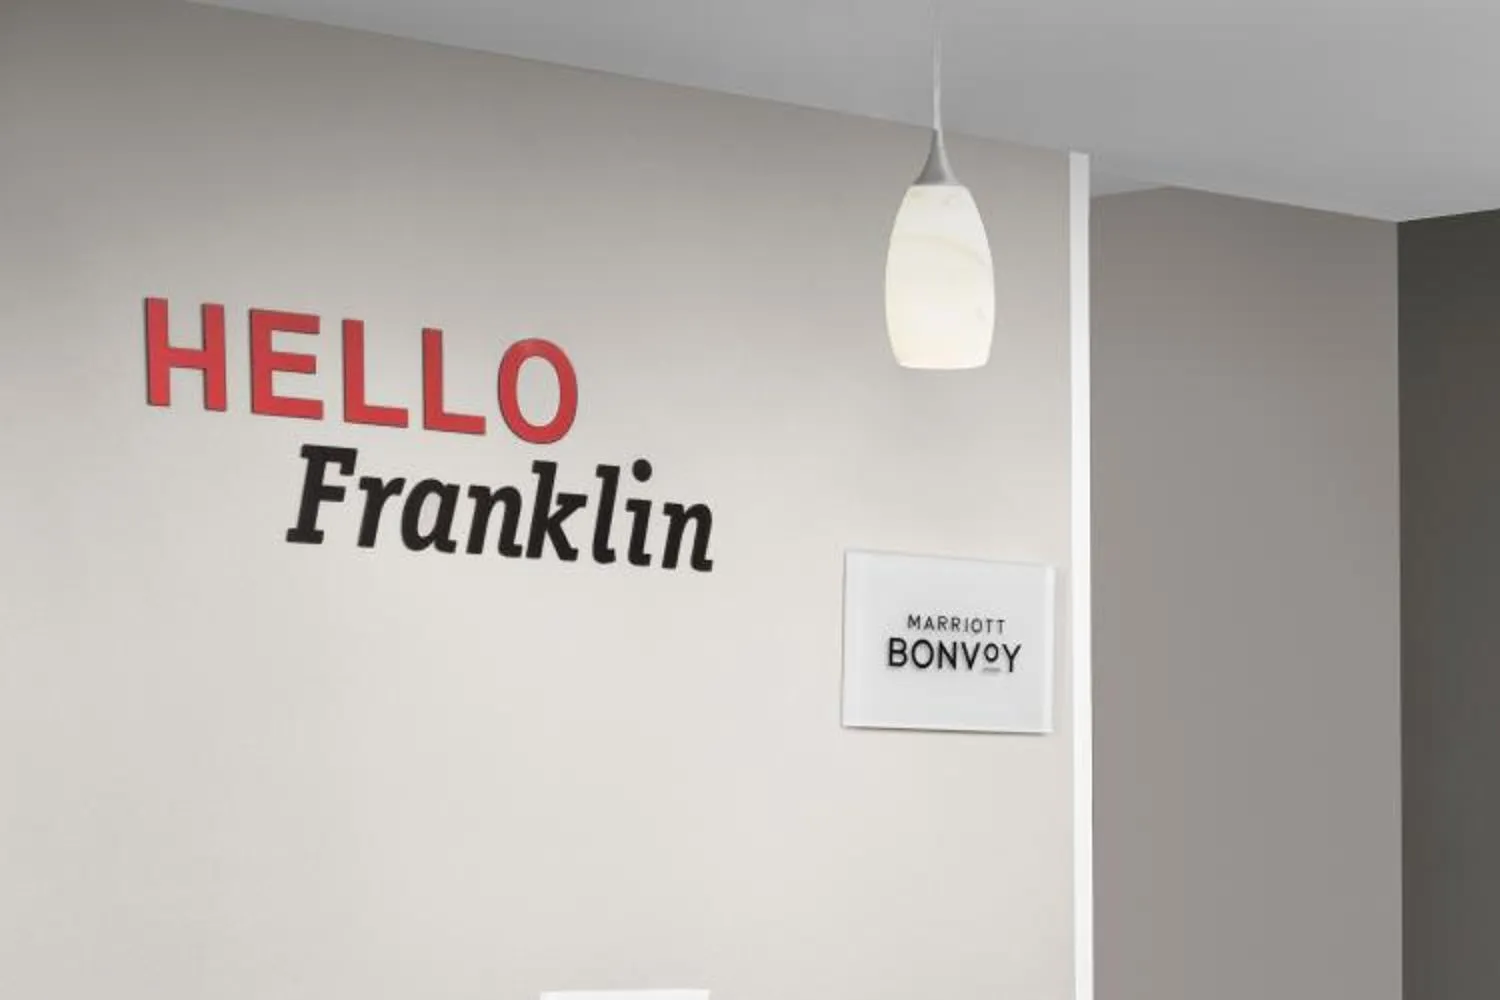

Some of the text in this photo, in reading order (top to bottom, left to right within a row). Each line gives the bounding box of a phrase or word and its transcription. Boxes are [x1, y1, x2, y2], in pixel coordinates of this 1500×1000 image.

[144, 296, 578, 445] HELLO
[285, 443, 714, 572] Franklin
[906, 613, 1006, 635] MARRIOTT
